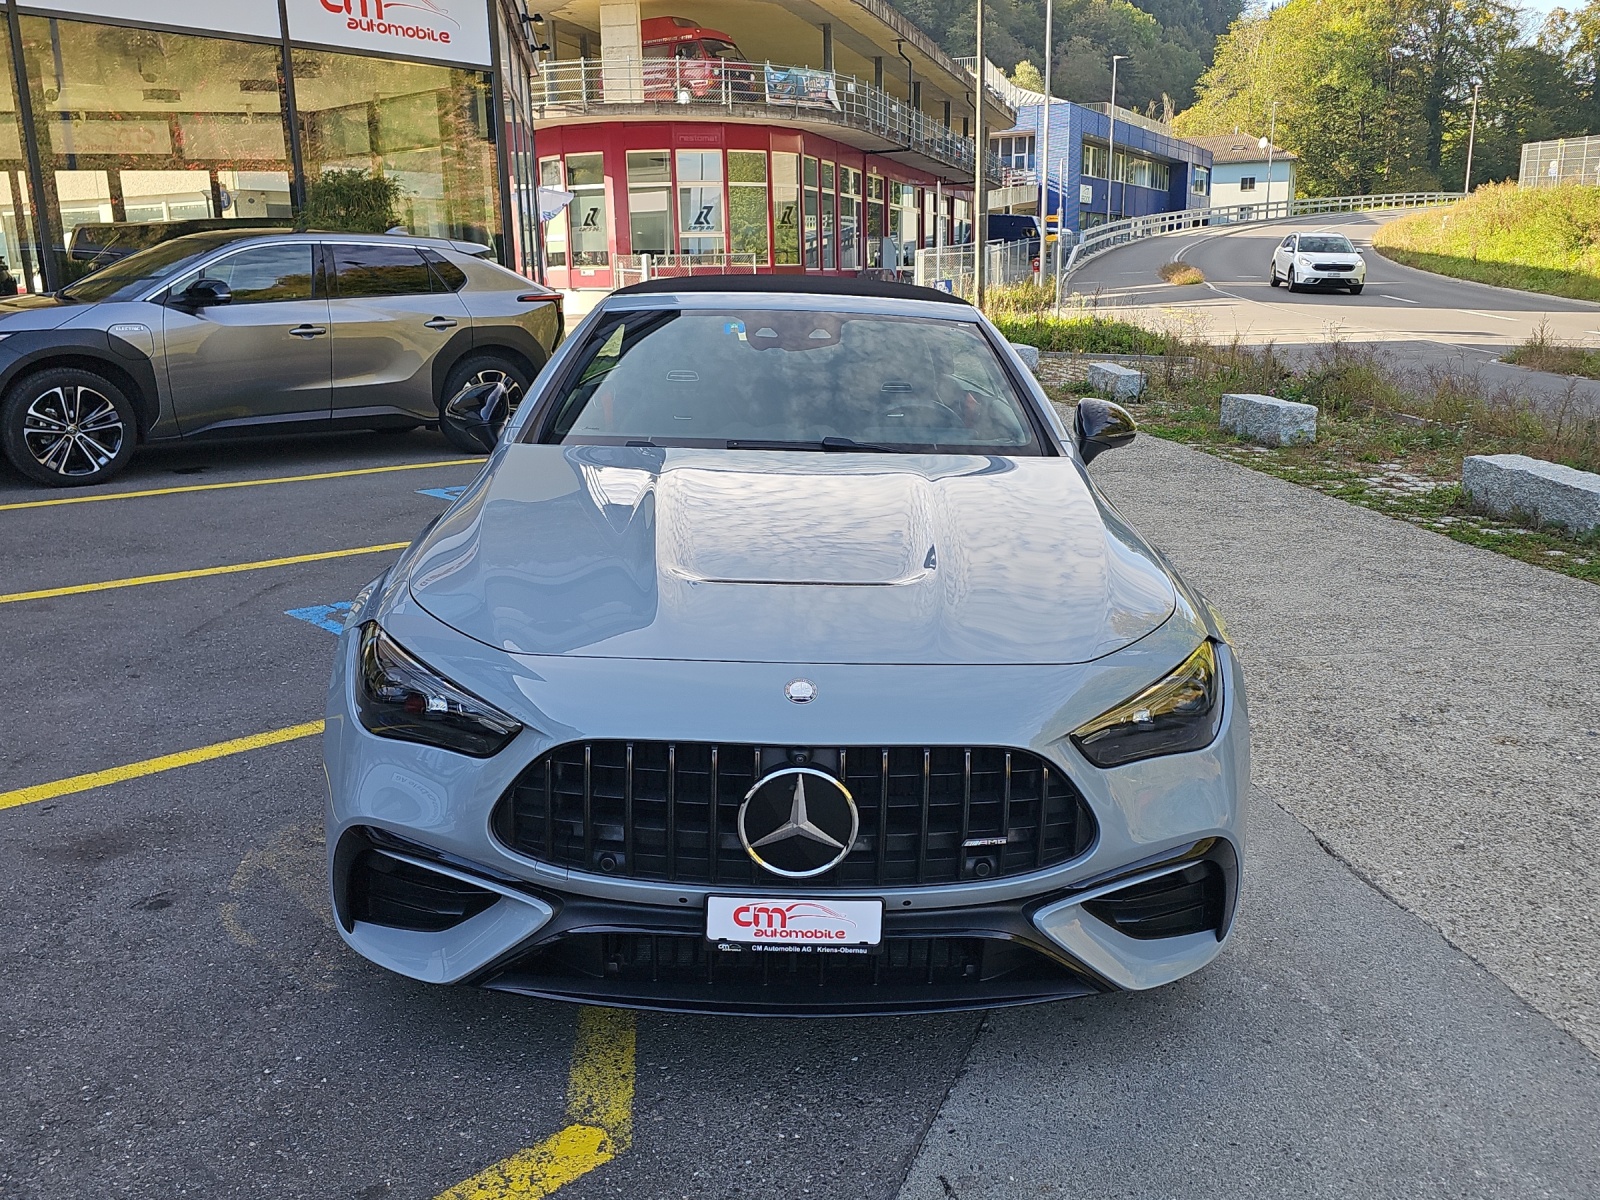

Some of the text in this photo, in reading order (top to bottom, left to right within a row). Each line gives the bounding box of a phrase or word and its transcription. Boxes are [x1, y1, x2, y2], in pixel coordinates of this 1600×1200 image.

[347, 17, 451, 43] automobile
[733, 905, 788, 929] cm
[753, 928, 846, 939] automobile
[764, 945, 801, 953] Automobile
[817, 947, 868, 955] Kriens-Obernau
